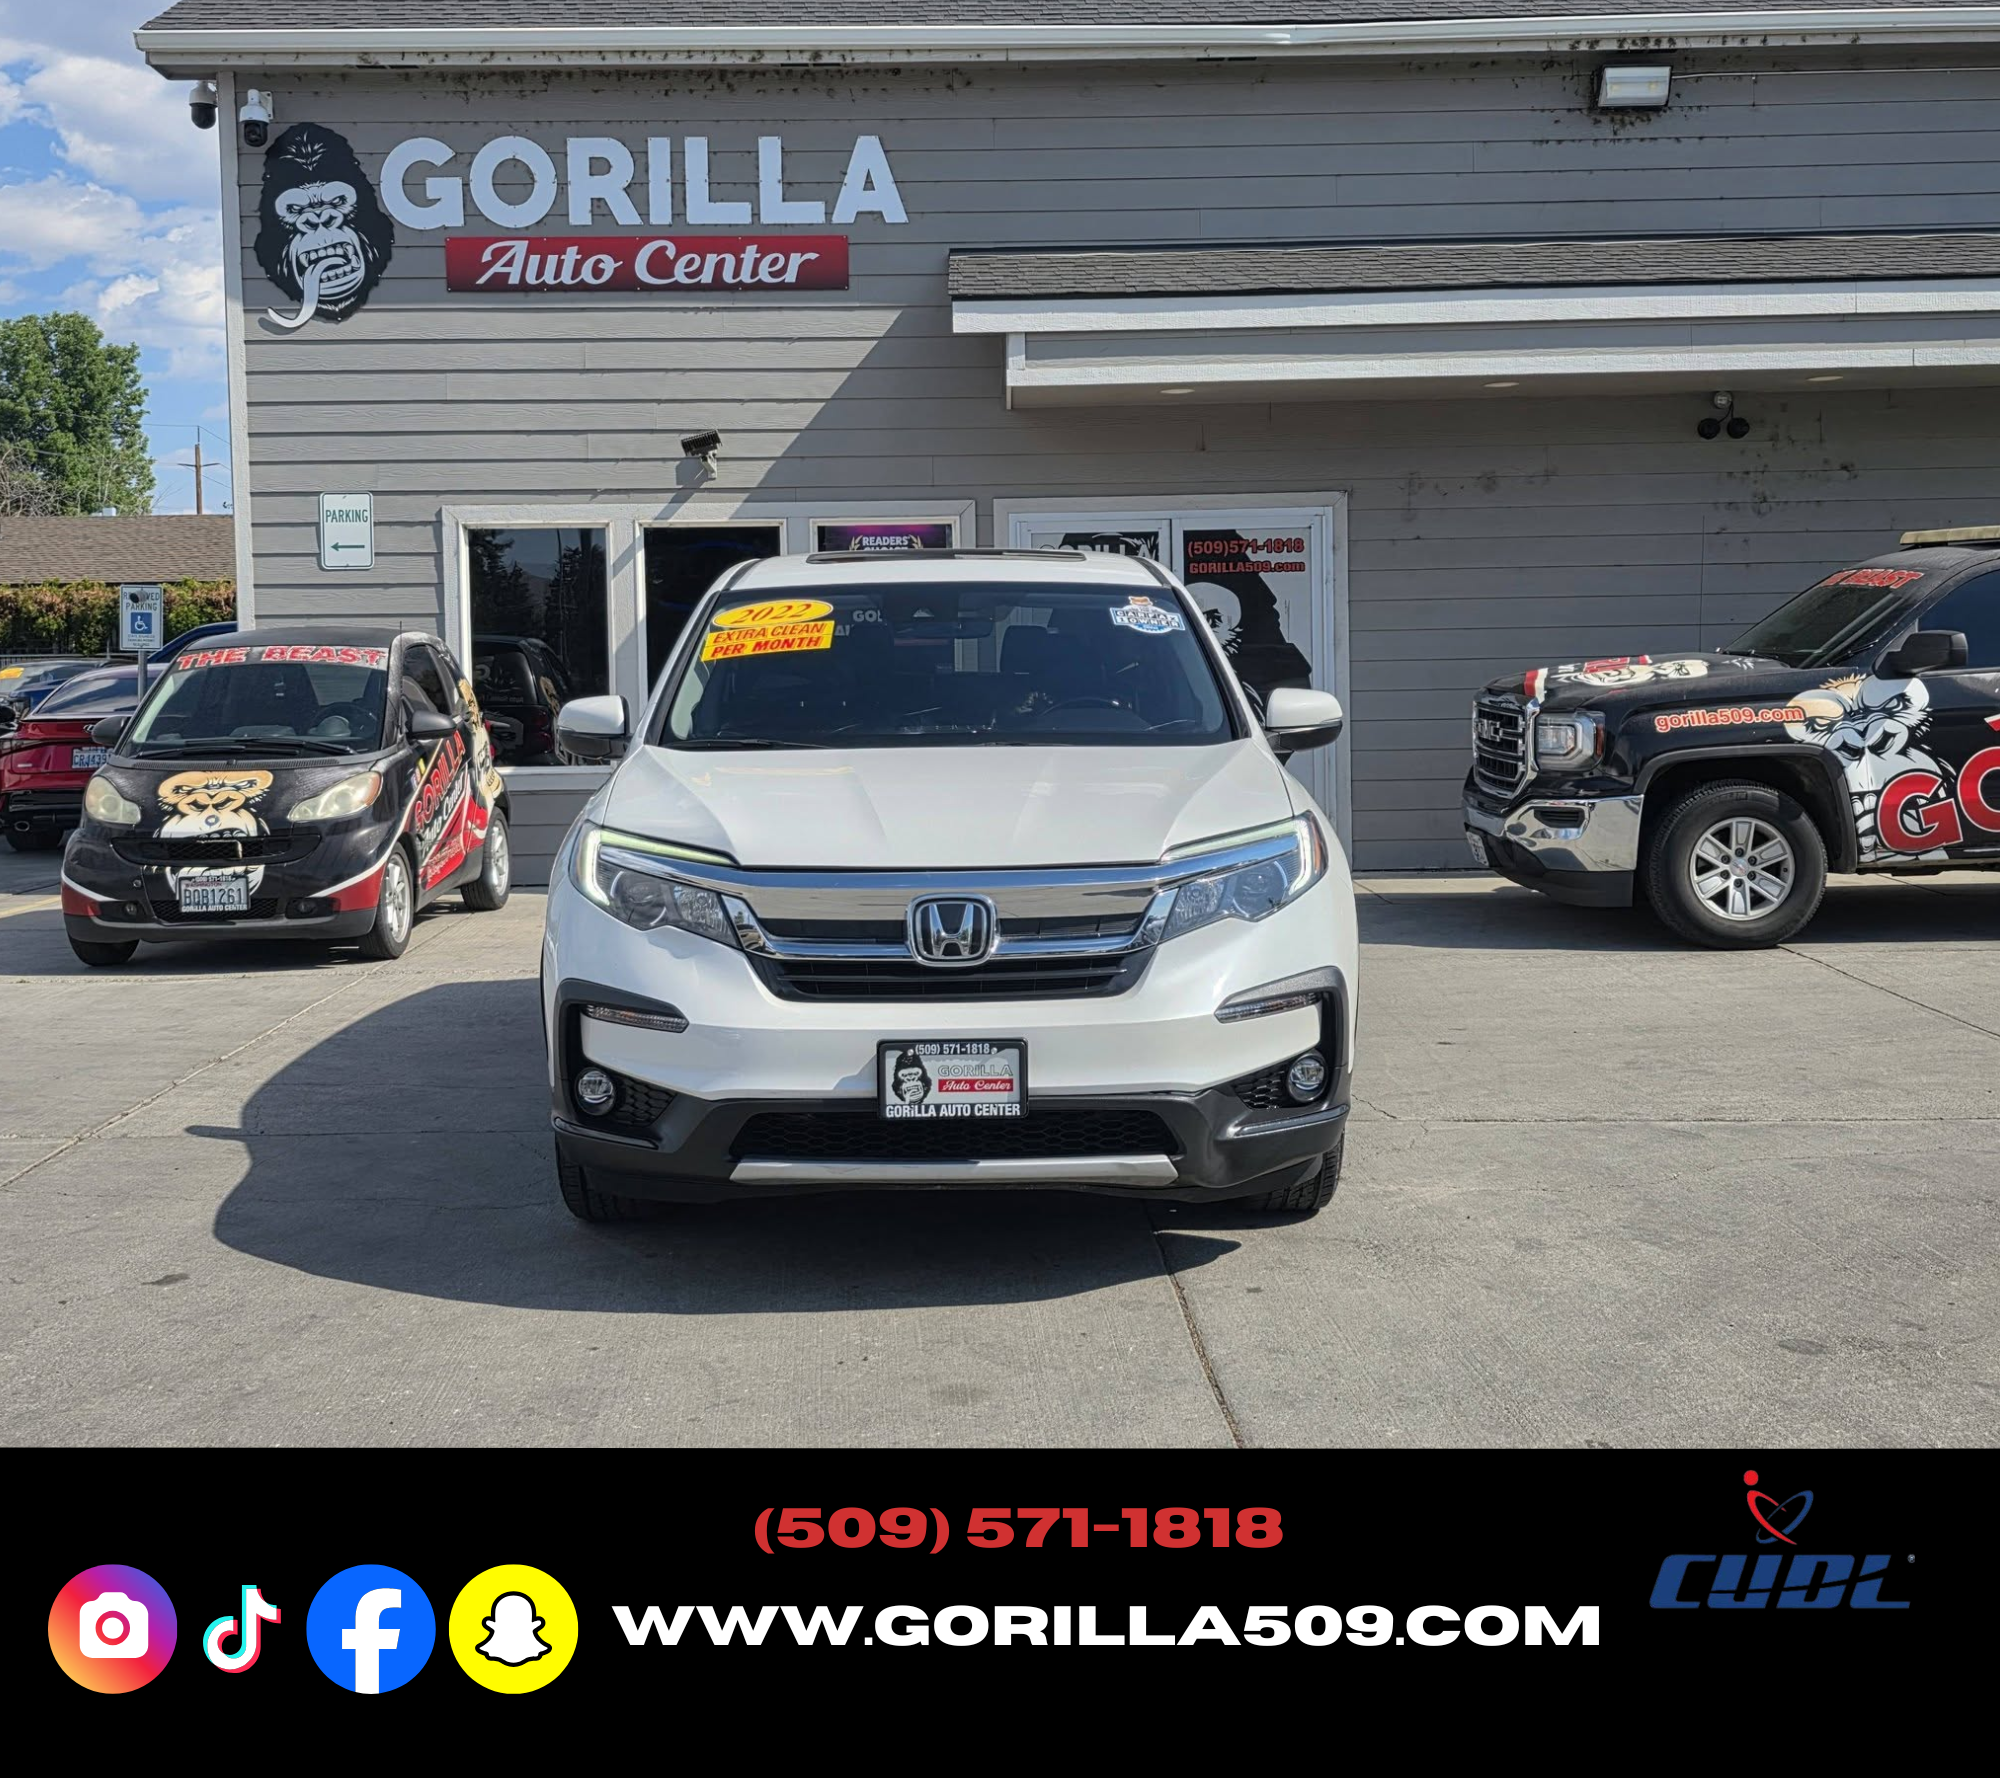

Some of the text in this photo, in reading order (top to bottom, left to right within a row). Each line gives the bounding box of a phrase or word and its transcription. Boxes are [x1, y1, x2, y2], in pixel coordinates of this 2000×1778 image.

[380, 135, 909, 230] GORILLA
[475, 239, 820, 285] Auto Center
[325, 509, 369, 523] PARKING
[1187, 538, 1305, 557] (509)571-1818
[1189, 560, 1306, 574] GORILLA509.com
[125, 602, 158, 612] PARKING
[730, 603, 812, 625] 2022
[713, 627, 768, 644] EXTRA
[770, 622, 825, 637] CLEAN
[711, 636, 823, 658] PER MONTH
[176, 645, 387, 671] THE BEAST
[1655, 706, 1805, 733] gorilla509.com
[414, 730, 466, 833] GORILLA
[915, 1043, 990, 1056] (509) 571-1818
[937, 1064, 1014, 1077] GORILLA
[942, 1079, 1012, 1091] Auto Center
[886, 1103, 1021, 1118] GORILLA AUTO CENTER
